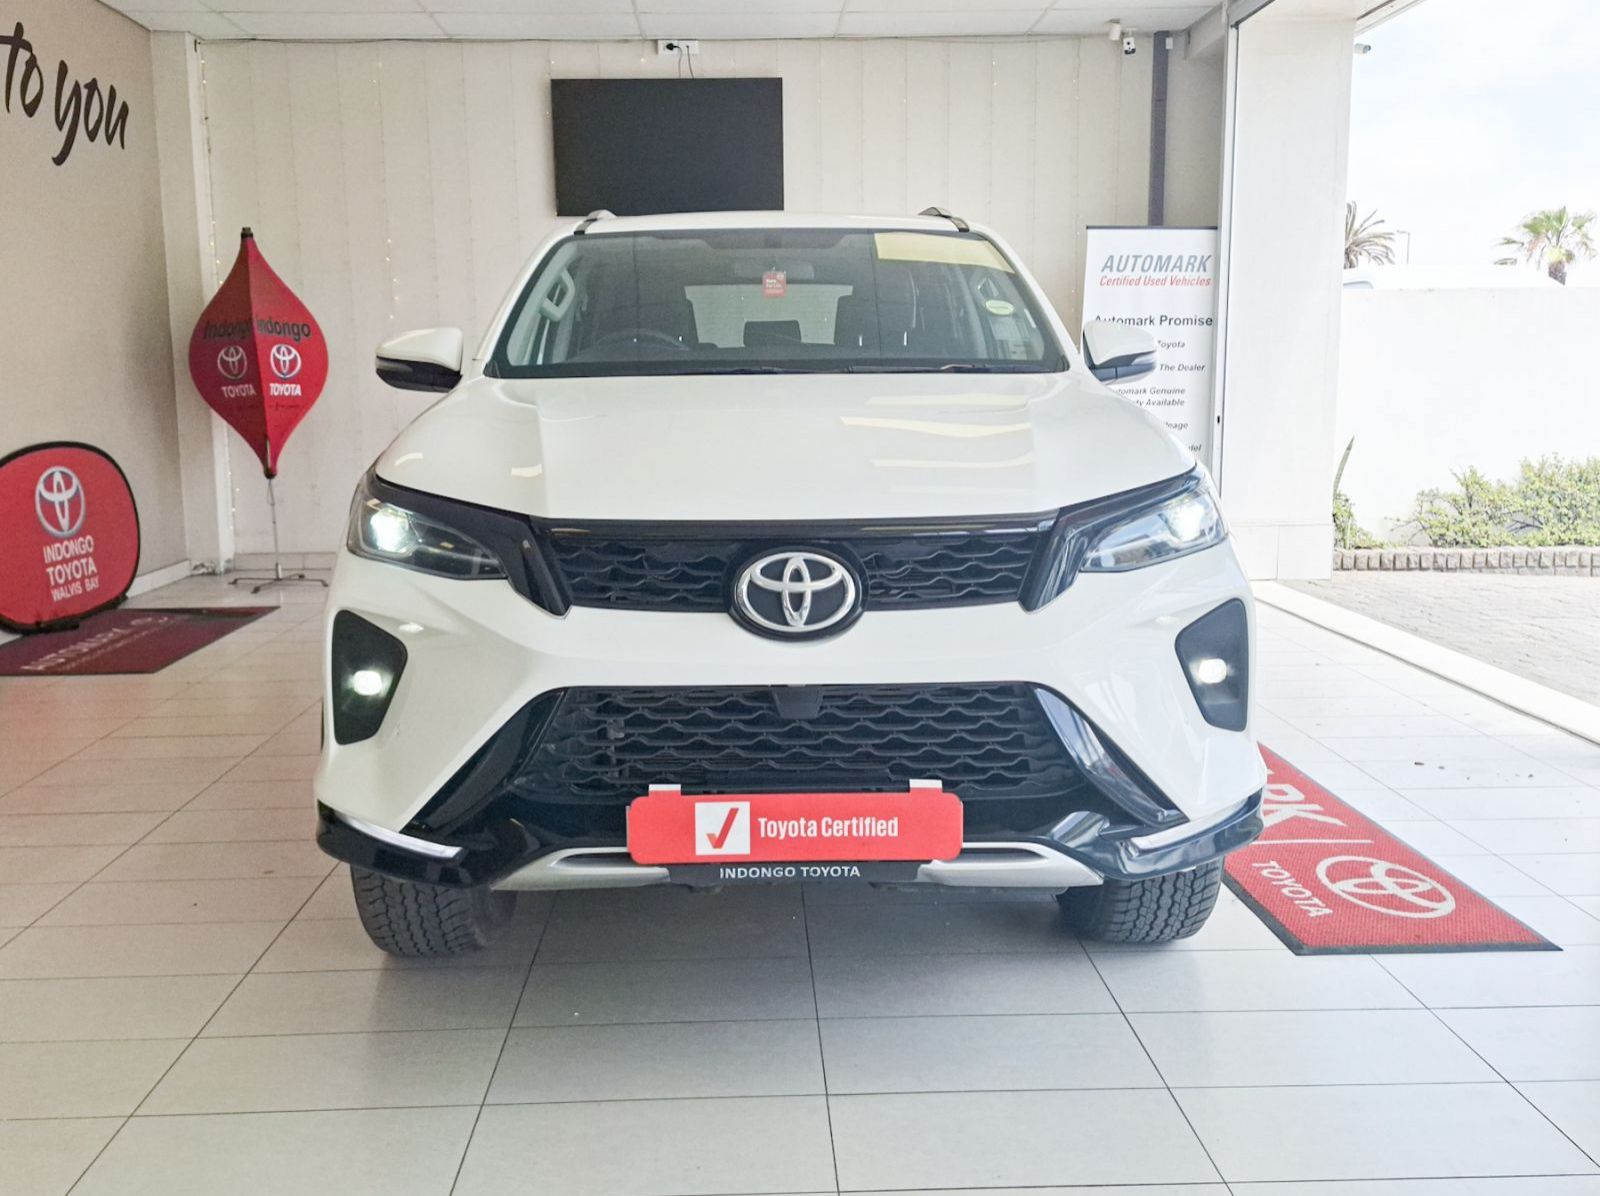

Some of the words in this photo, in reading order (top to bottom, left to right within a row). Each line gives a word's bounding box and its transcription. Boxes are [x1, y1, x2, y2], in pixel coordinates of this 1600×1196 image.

[51, 60, 129, 166] you
[1101, 254, 1212, 273] AUTOMARK
[1099, 275, 1141, 287] Certified
[1143, 275, 1166, 287] Used
[1170, 275, 1211, 287] Vehicles
[1095, 315, 1155, 326] Atomark
[1160, 315, 1213, 326] Promise
[1159, 364, 1175, 372] The
[1178, 364, 1205, 372] Dealer
[222, 384, 256, 398] TOYOTA
[270, 382, 302, 396] TOYOTA
[1150, 387, 1185, 395] Genuine
[43, 535, 94, 564] INDONGO
[46, 558, 97, 586] TOYOTA
[51, 583, 83, 601] WALVIS
[85, 577, 99, 592] BAY
[758, 817, 818, 839] Toyota
[720, 867, 796, 879] INDONGO
[800, 865, 860, 877] TOYOTA
[1252, 859, 1334, 918] TOYOTA
